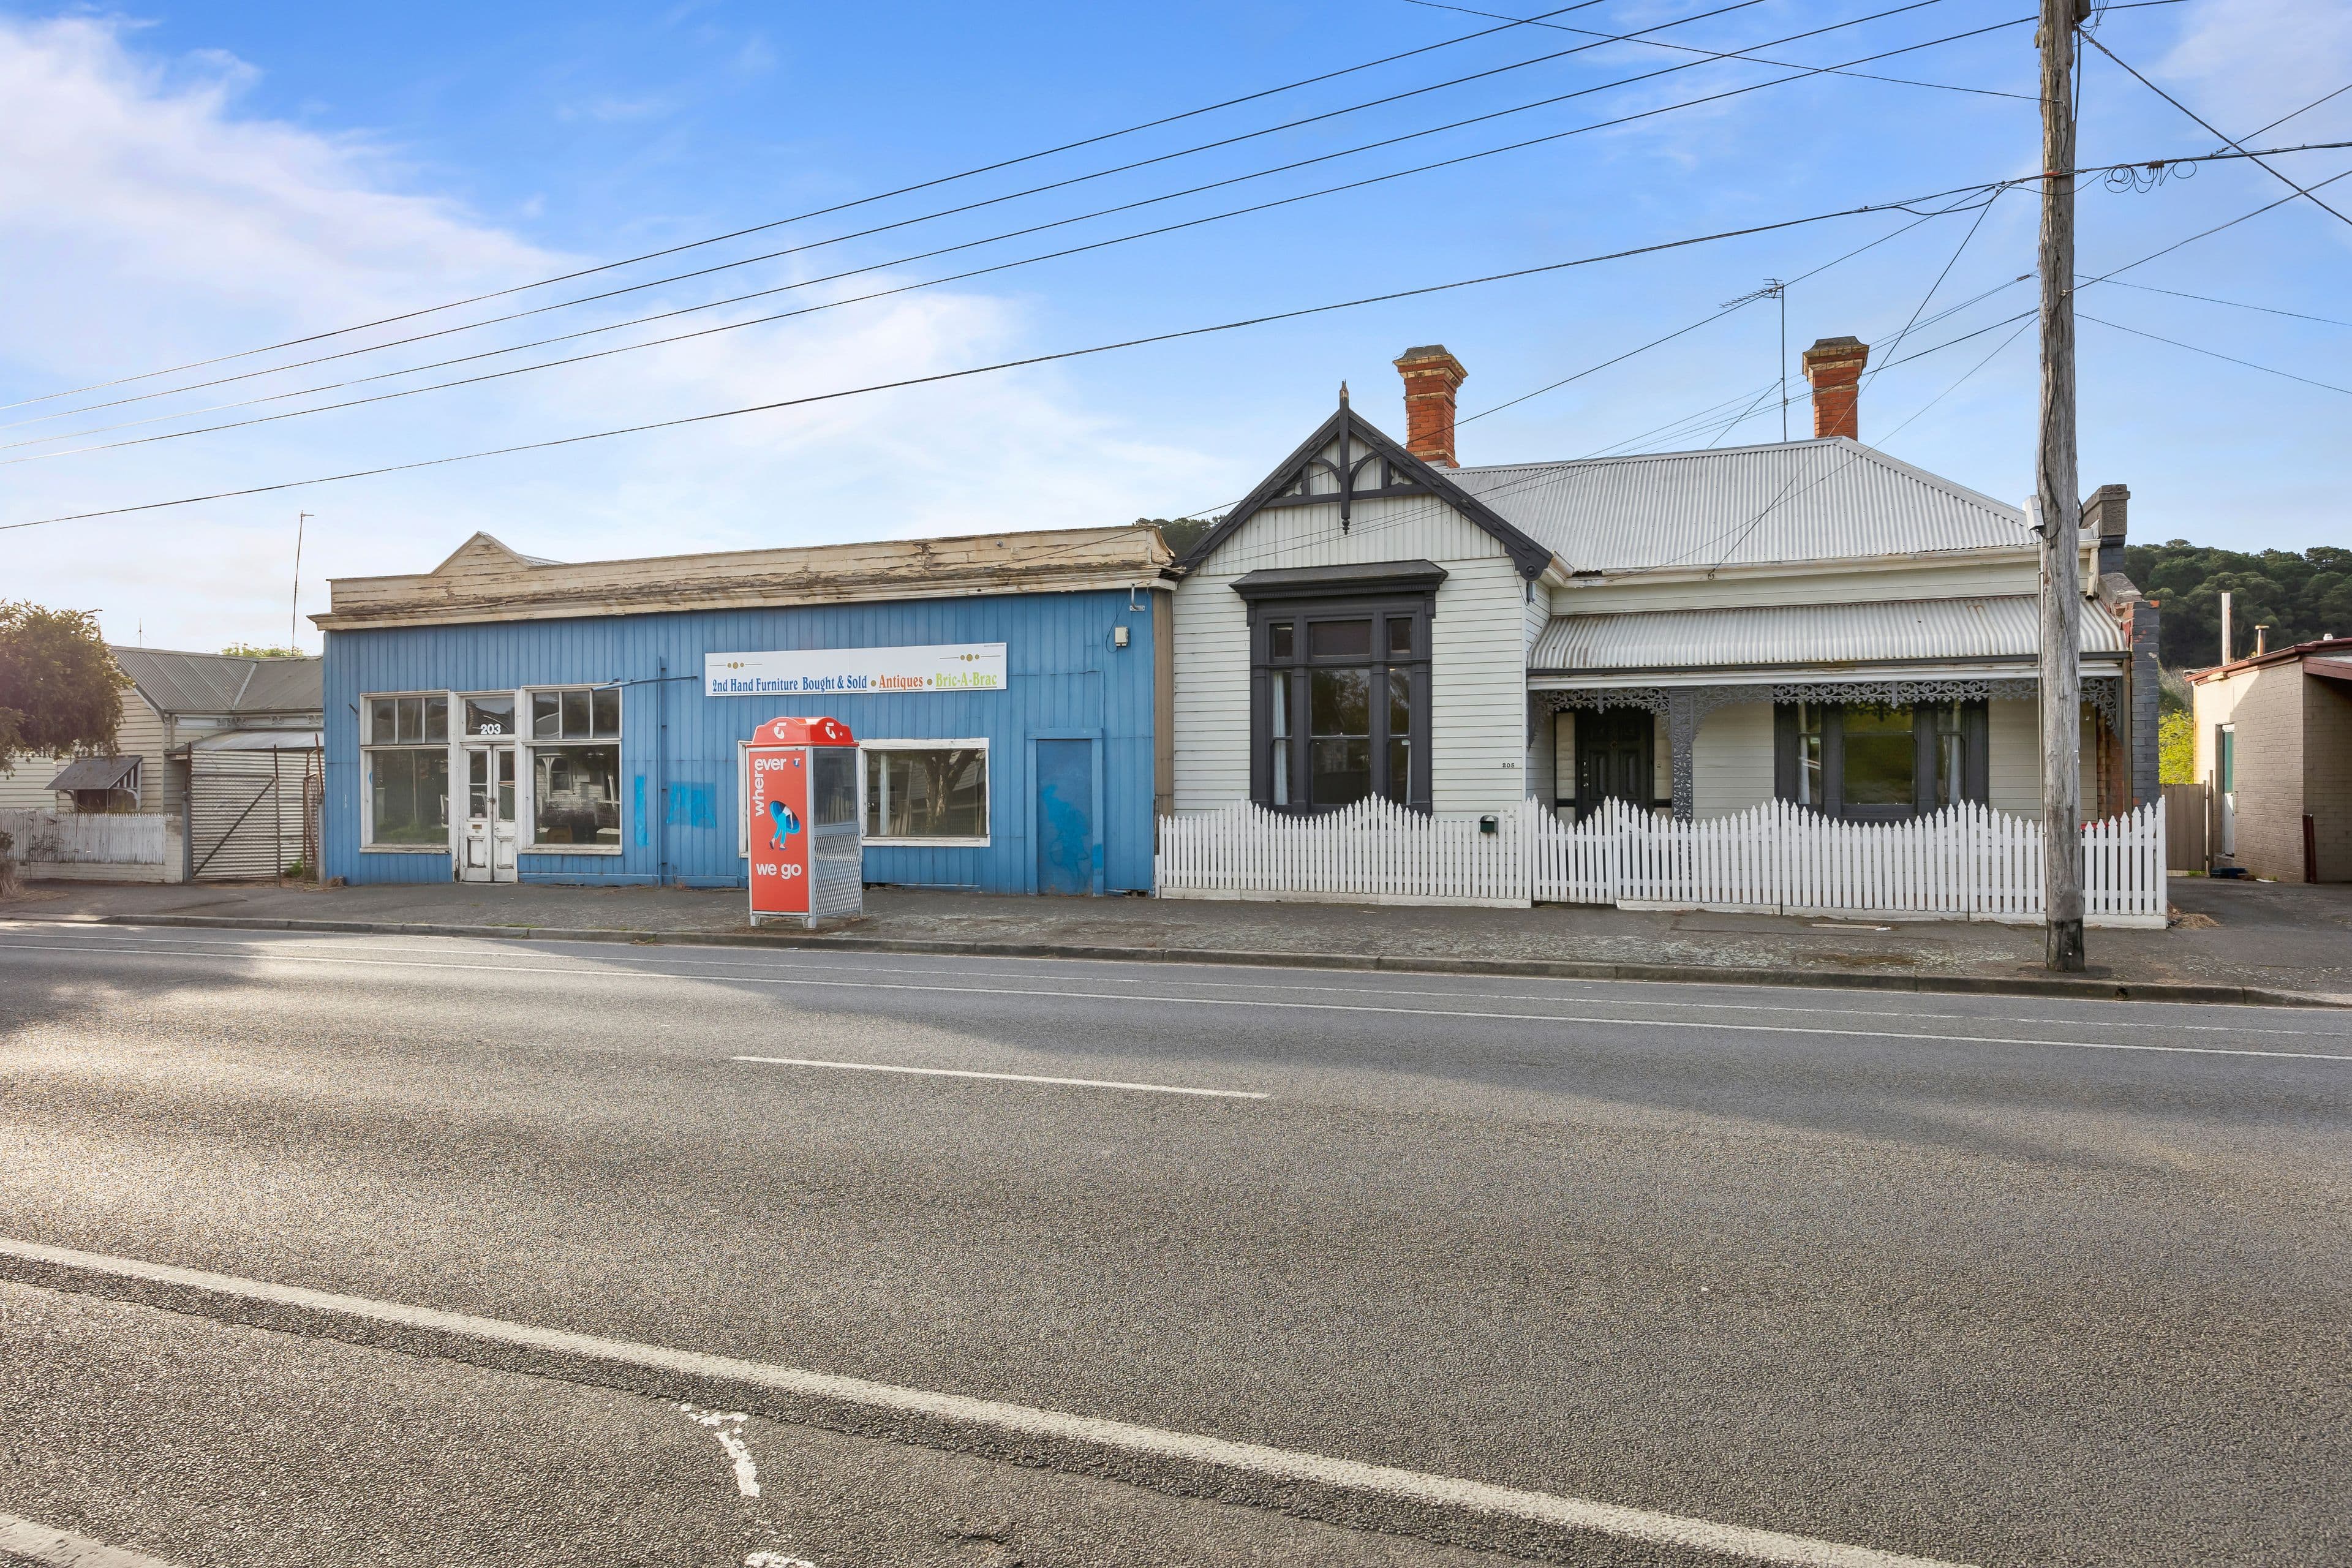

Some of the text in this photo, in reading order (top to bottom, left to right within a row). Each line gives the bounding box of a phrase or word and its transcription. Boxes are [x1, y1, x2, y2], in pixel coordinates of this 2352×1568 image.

[712, 671, 998, 693] 2nd Hand Furniture Bought & Sold Antiques Bric-A-Brac
[480, 723, 501, 734] 203
[755, 863, 802, 880] we go
